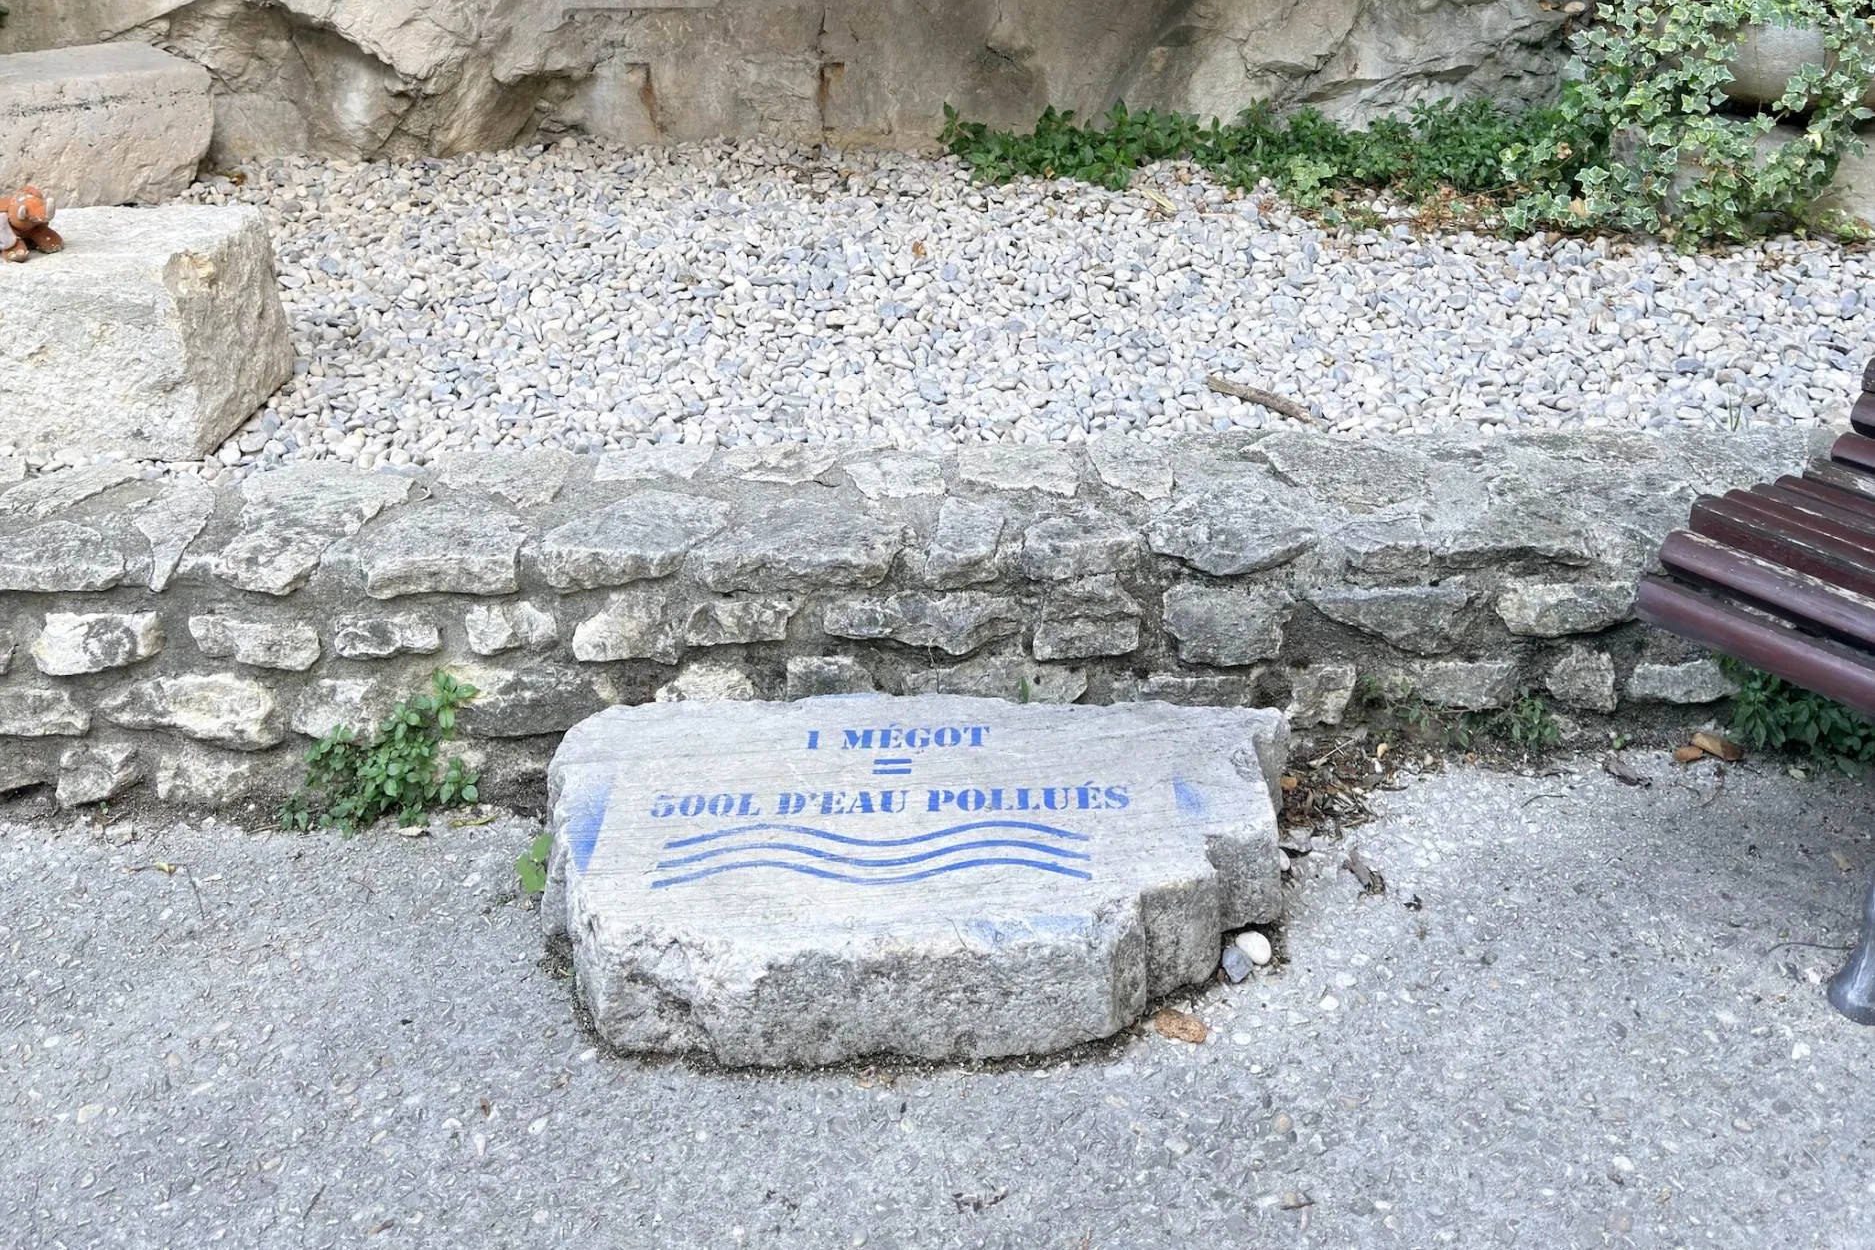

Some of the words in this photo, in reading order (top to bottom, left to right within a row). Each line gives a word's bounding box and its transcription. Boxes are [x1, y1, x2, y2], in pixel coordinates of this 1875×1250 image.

[842, 722, 991, 750] MÉGOT
[650, 793, 761, 819] 500L
[775, 789, 908, 815] D'EAU
[927, 780, 1130, 813] POLLUÉS
